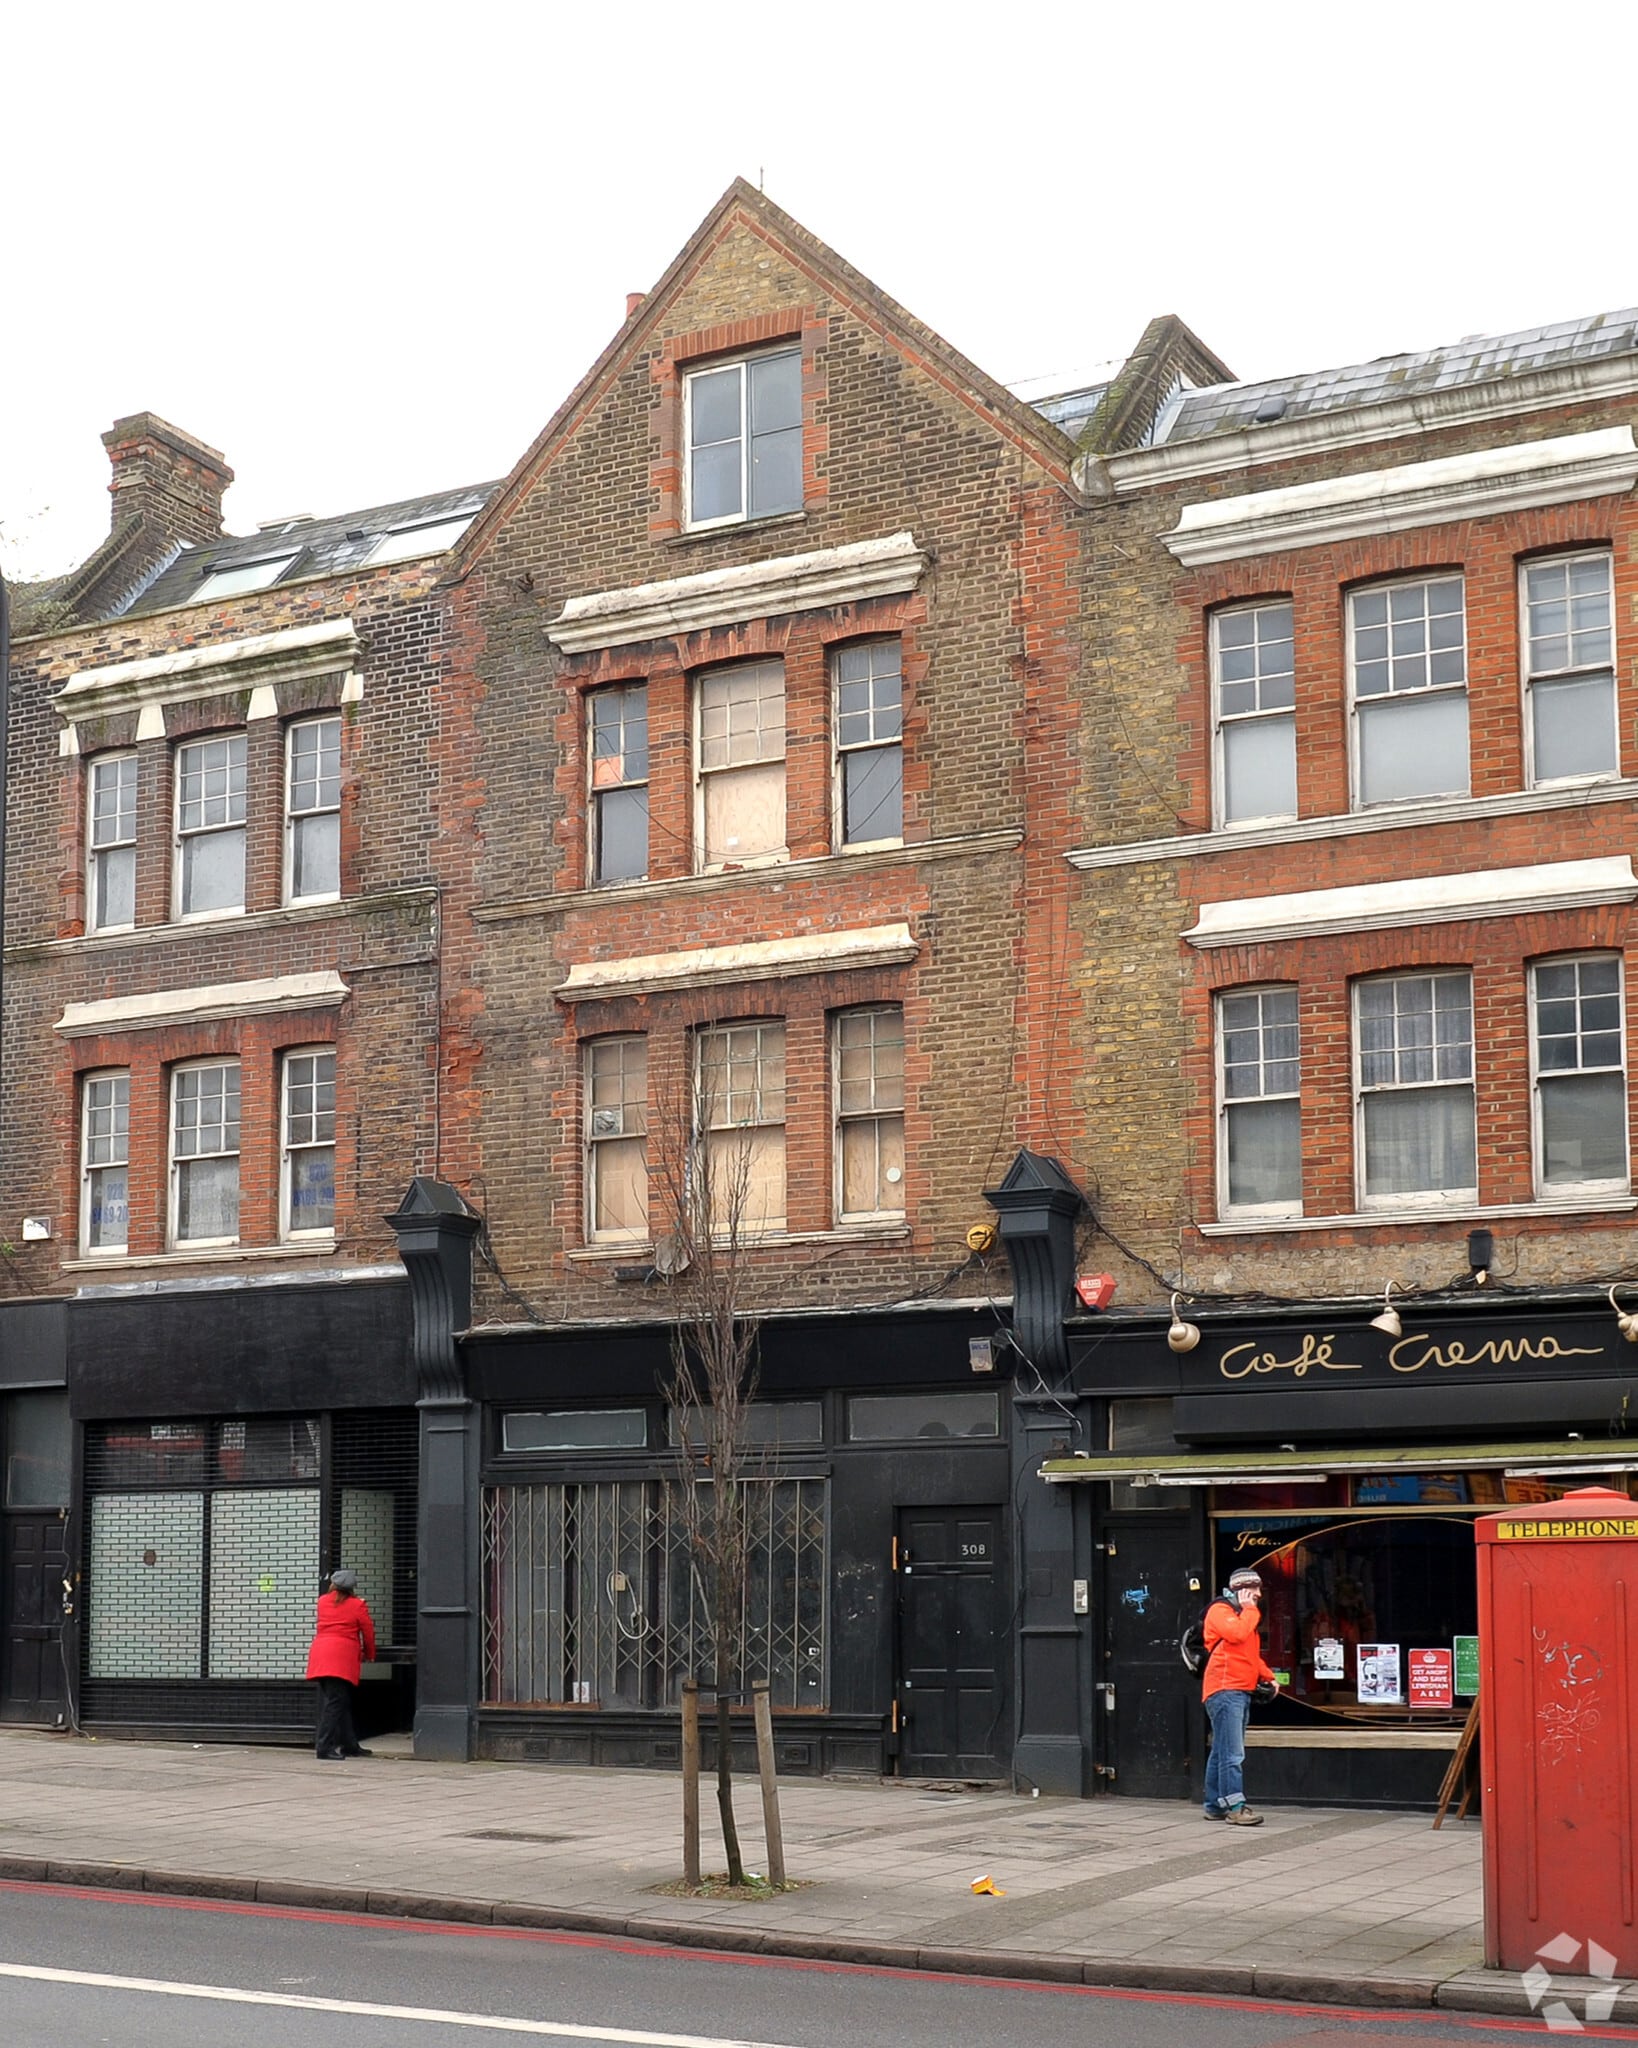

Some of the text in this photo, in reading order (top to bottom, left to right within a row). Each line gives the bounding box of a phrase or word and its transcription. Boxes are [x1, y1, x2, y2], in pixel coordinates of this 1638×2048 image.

[1220, 1333, 1604, 1379] Café Crema
[1506, 1520, 1636, 1538] TELEPHONE
[961, 1543, 985, 1556] 308
